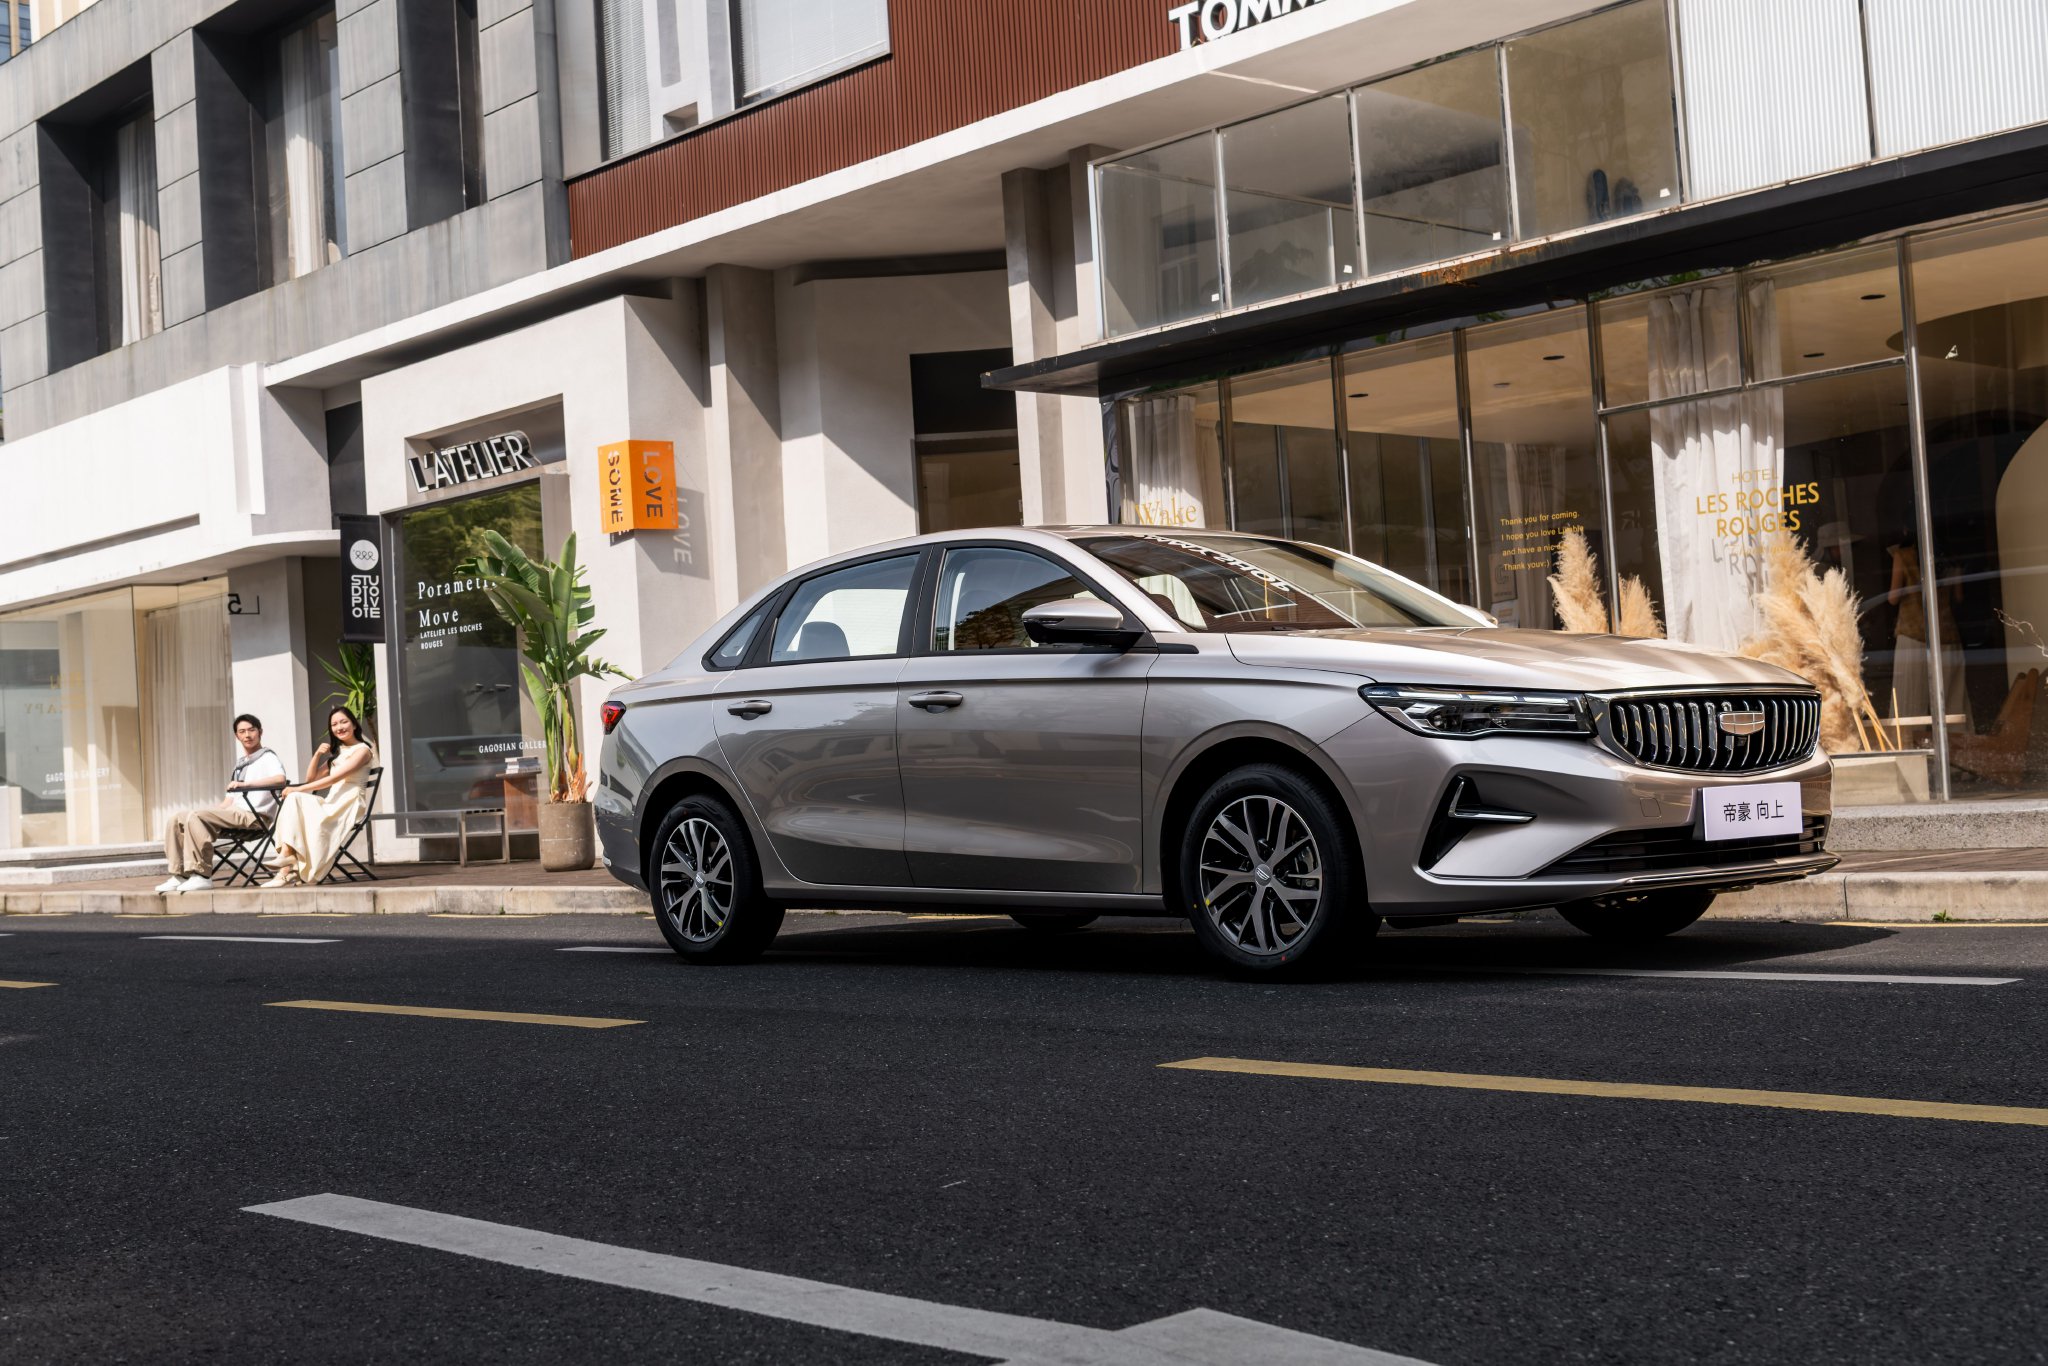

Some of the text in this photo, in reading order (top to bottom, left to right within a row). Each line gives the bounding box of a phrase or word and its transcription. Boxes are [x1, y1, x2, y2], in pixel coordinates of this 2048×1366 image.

[408, 435, 532, 493] L'ATELIER
[643, 450, 663, 518] LOVE
[1732, 468, 1779, 484] HOTEL
[608, 450, 624, 525] SOME
[1696, 482, 1820, 515] LES ROCHES
[1500, 517, 1523, 526] Thank
[1524, 516, 1537, 525] you
[1540, 513, 1549, 521] for
[1717, 509, 1801, 538] ROUGES
[1506, 532, 1524, 541] hope
[1525, 531, 1539, 540] you
[1540, 528, 1556, 536] love
[1502, 548, 1516, 557] and
[1517, 546, 1535, 555] have
[1503, 562, 1525, 571] Thank
[419, 608, 459, 628] Move
[447, 626, 458, 635] LES
[459, 622, 483, 633] ROCHES
[420, 640, 444, 650] ROUGES
[478, 742, 516, 754] GAGOSIAN
[1723, 799, 1784, 823] 帝豪 向上
